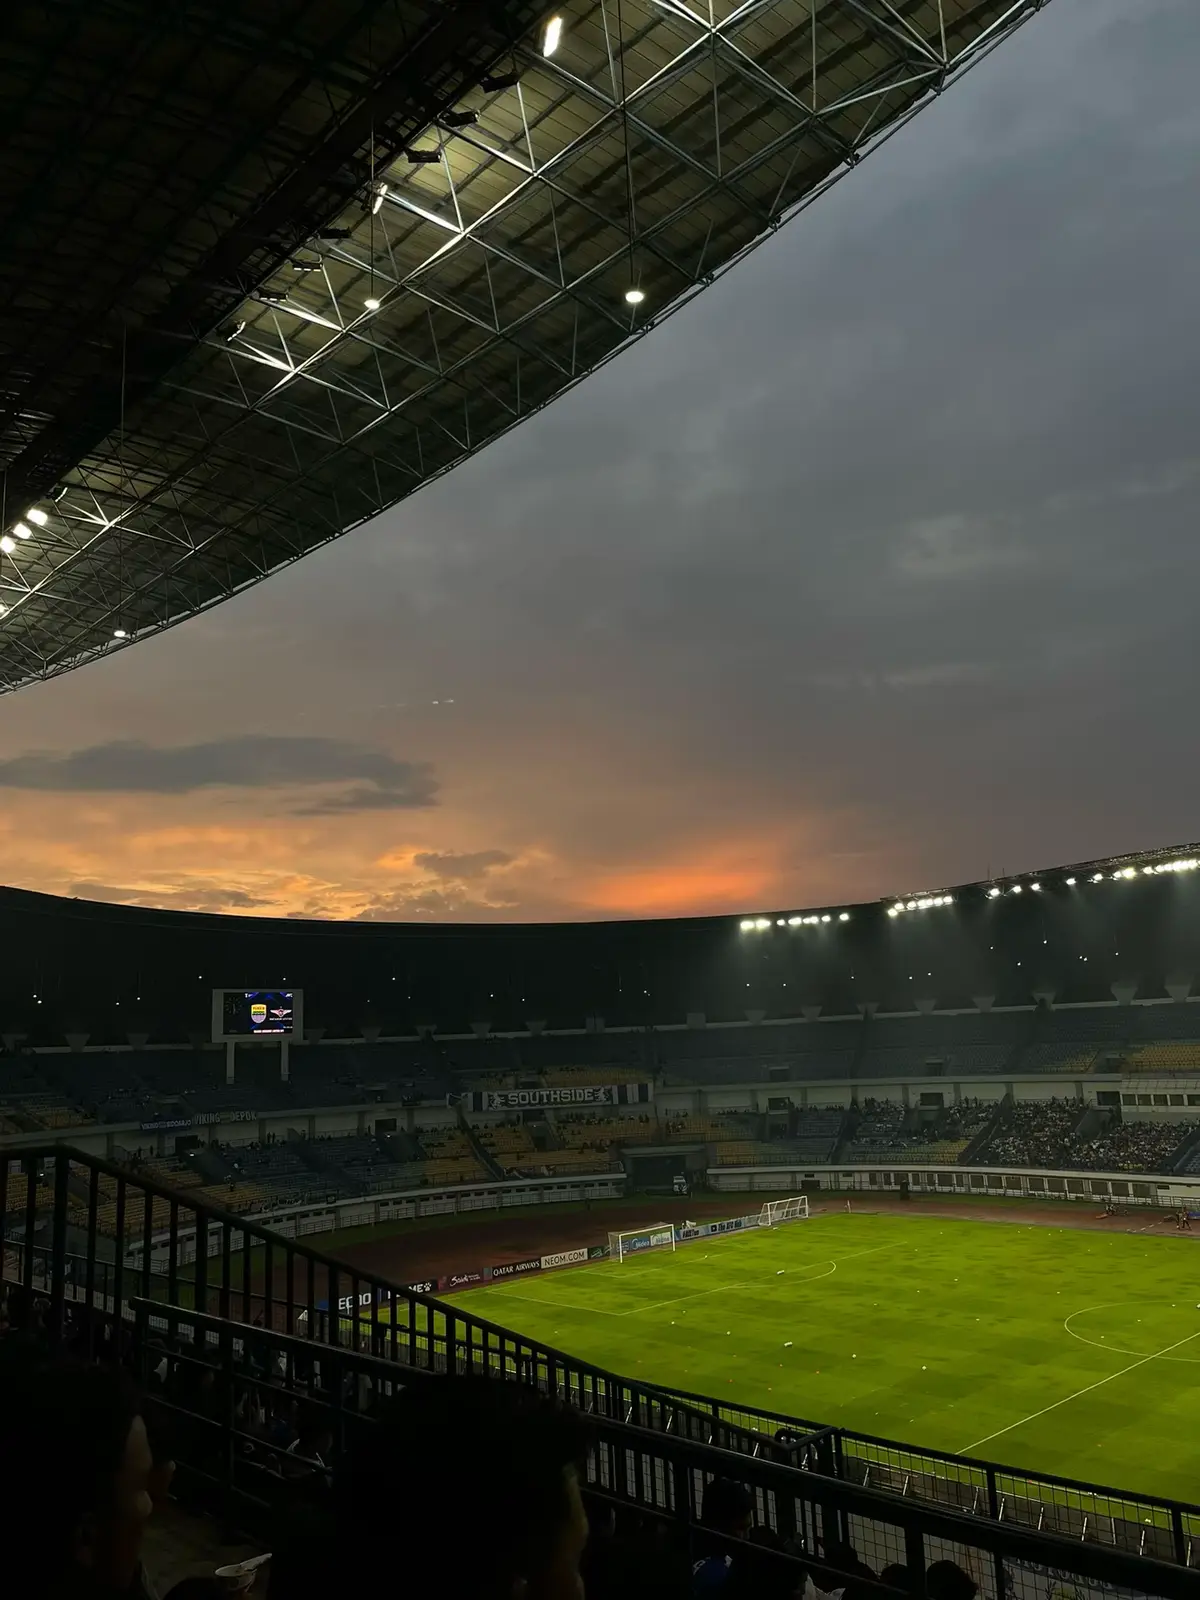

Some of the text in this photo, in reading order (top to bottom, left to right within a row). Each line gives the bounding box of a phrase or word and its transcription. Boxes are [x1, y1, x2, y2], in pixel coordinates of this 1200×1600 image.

[507, 1088, 595, 1105] SOUTHSIDE
[195, 1111, 221, 1125] VIKING
[544, 1250, 585, 1267] NEOM.COM
[493, 1259, 541, 1277] QATAR AIRWAYS
